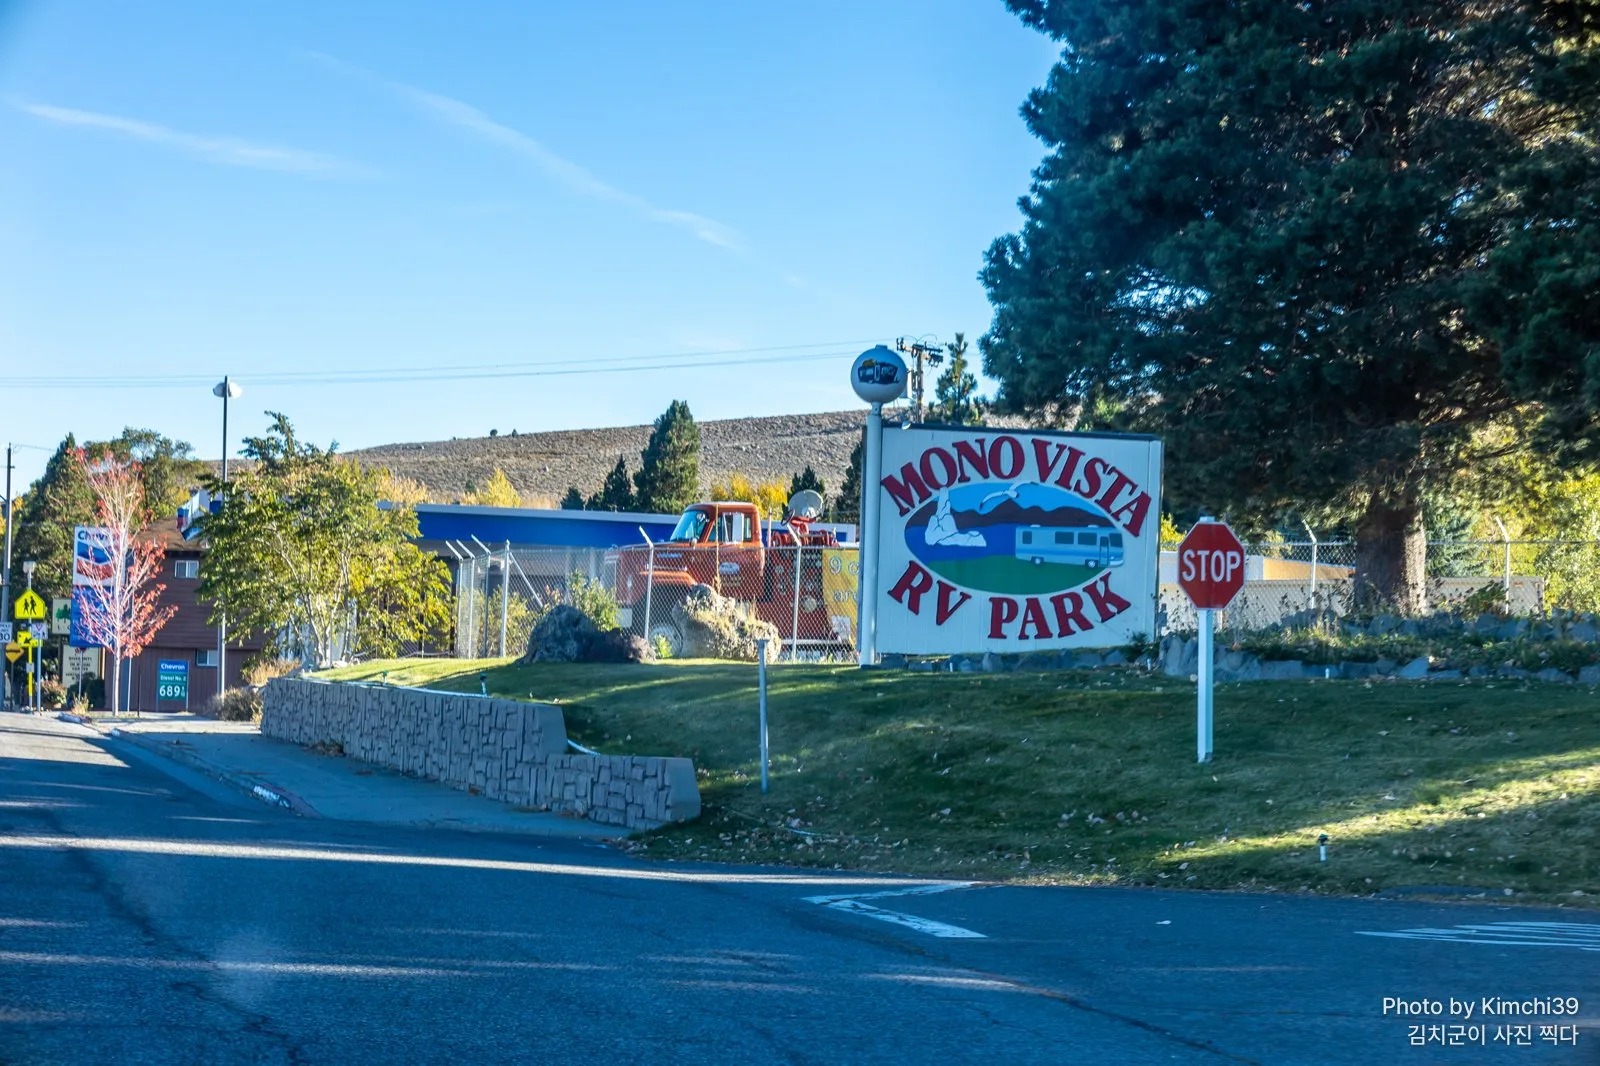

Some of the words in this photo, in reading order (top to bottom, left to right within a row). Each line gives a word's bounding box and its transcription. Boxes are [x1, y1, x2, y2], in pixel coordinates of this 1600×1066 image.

[881, 436, 1025, 518] MONO
[1031, 438, 1152, 538] VISTA
[1181, 549, 1241, 583] STOP
[888, 560, 972, 626] RV
[988, 571, 1132, 640] PARK
[159, 685, 180, 697] 689
